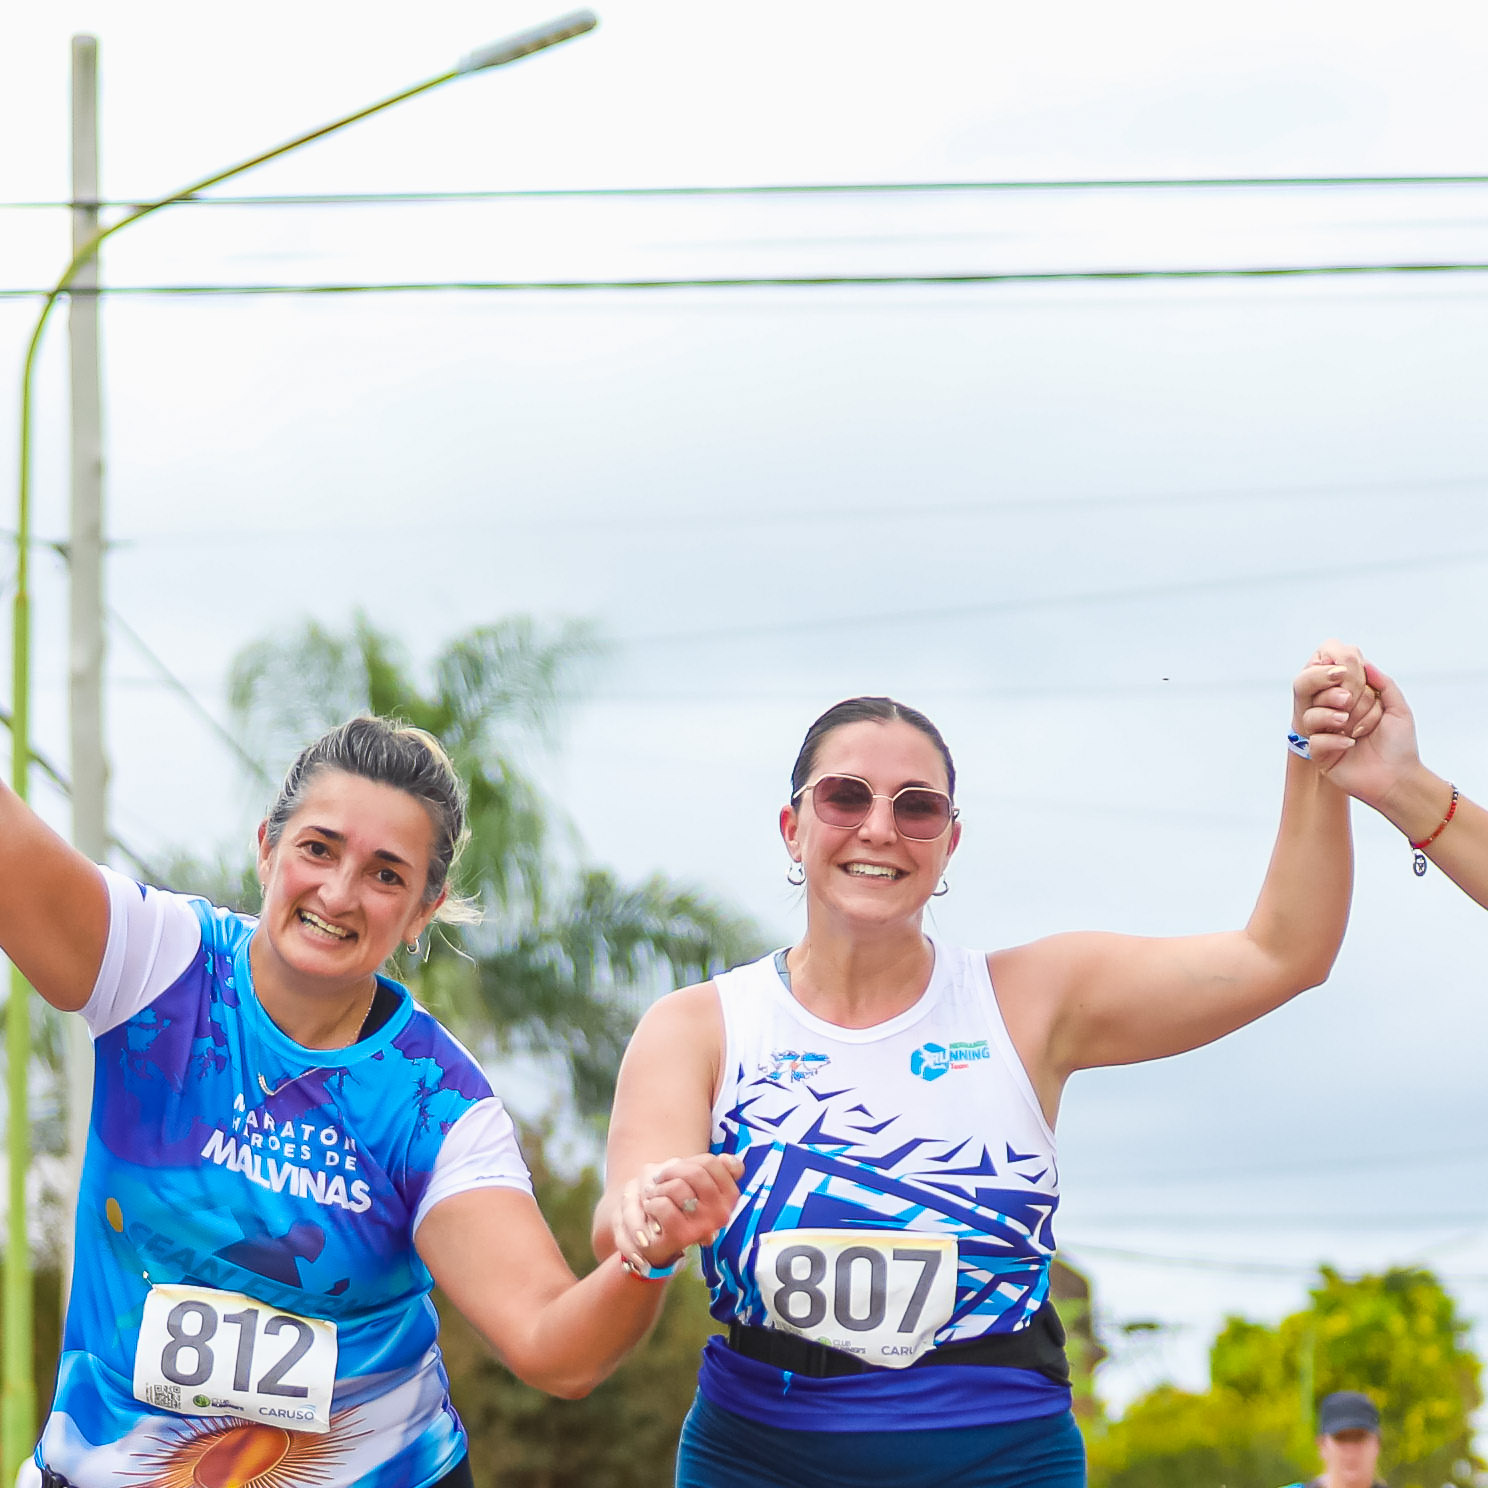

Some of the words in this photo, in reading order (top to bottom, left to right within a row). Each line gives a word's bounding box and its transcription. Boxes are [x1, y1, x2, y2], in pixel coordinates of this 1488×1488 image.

[200, 1128, 373, 1214] MALVINAS
[325, 1150, 357, 1172] DE
[773, 1244, 943, 1334] 807
[160, 1300, 316, 1399] 812
[258, 1407, 315, 1422] CARUSO
